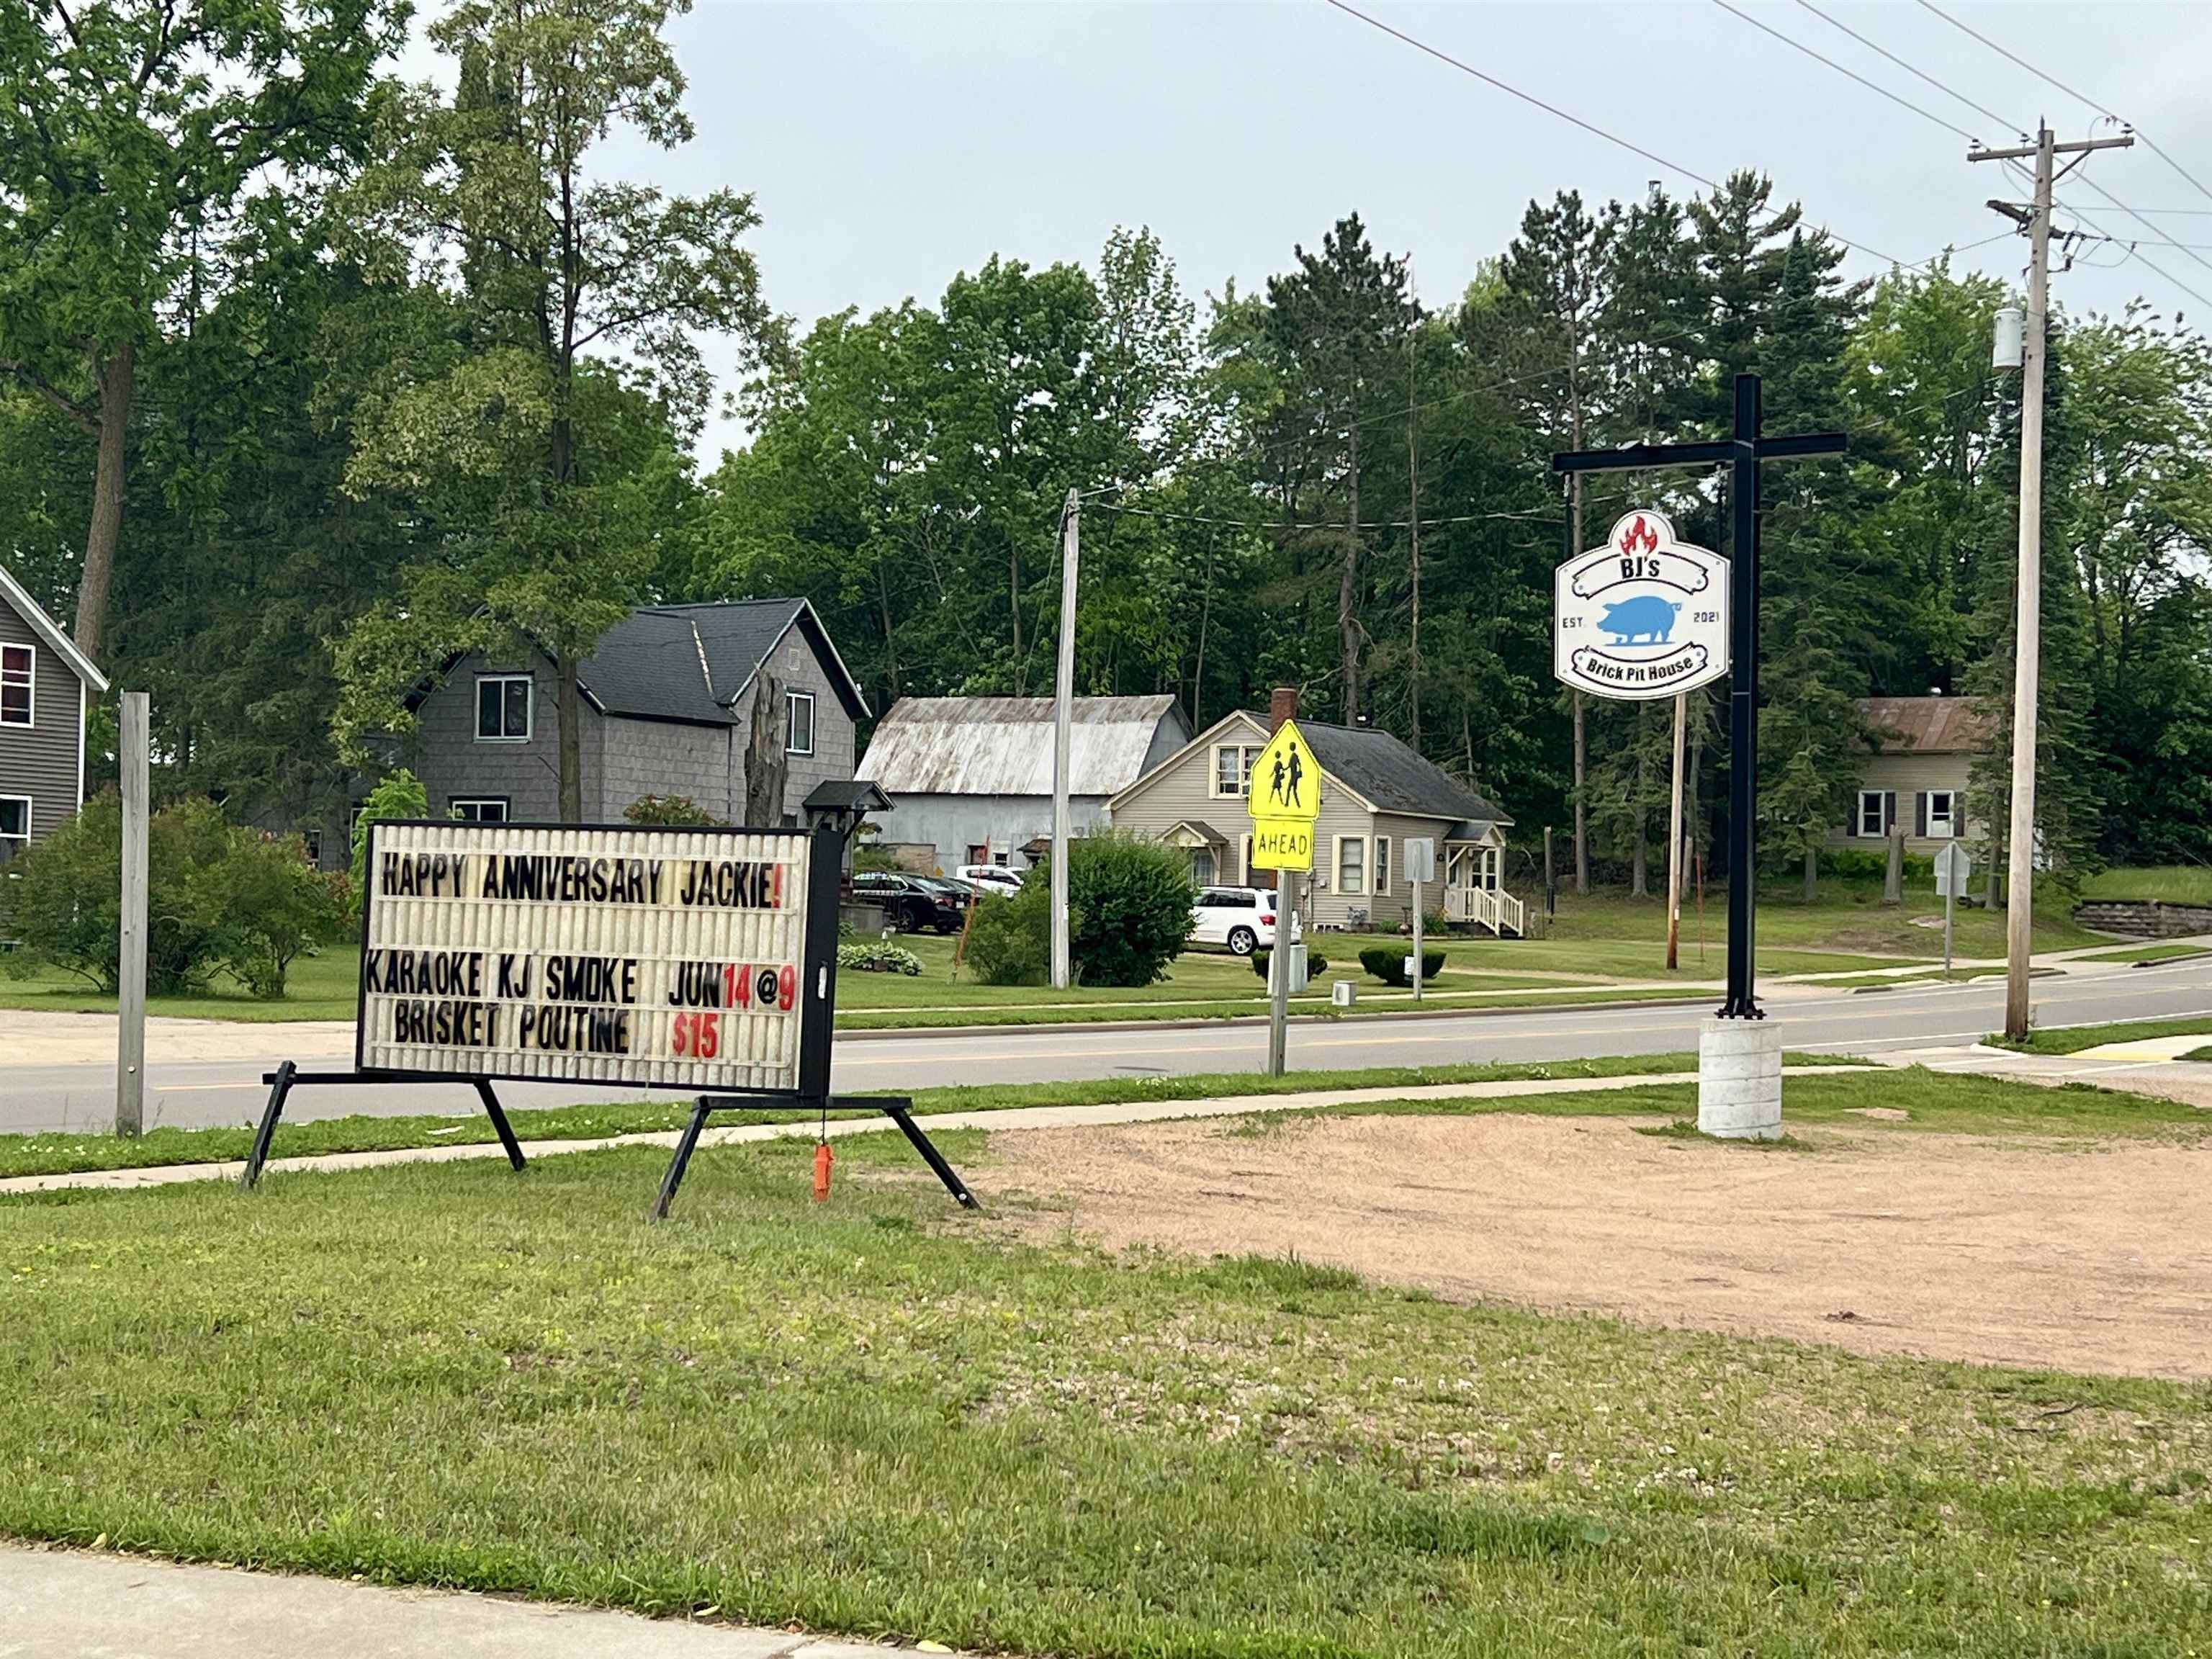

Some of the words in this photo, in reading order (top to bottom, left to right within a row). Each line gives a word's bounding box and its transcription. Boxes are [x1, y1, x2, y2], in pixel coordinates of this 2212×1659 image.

[1620, 556, 1660, 579] BJ'S
[1694, 611, 1719, 623] 2021
[1586, 658, 1624, 680] Brick
[1626, 667, 1645, 681] Pit
[1648, 657, 1694, 680] House
[1258, 833, 1307, 855] AHEAD
[383, 853, 466, 898] HAPPY
[482, 854, 662, 904] ANNIVERSARY
[680, 860, 783, 909] JACKIE!
[367, 949, 482, 997] KARAOKE
[498, 953, 531, 999] KJ
[547, 956, 637, 1004] SMOKE
[395, 999, 502, 1046] BRISKET
[520, 1004, 629, 1053] POUTINE
[673, 1010, 719, 1059] $15
